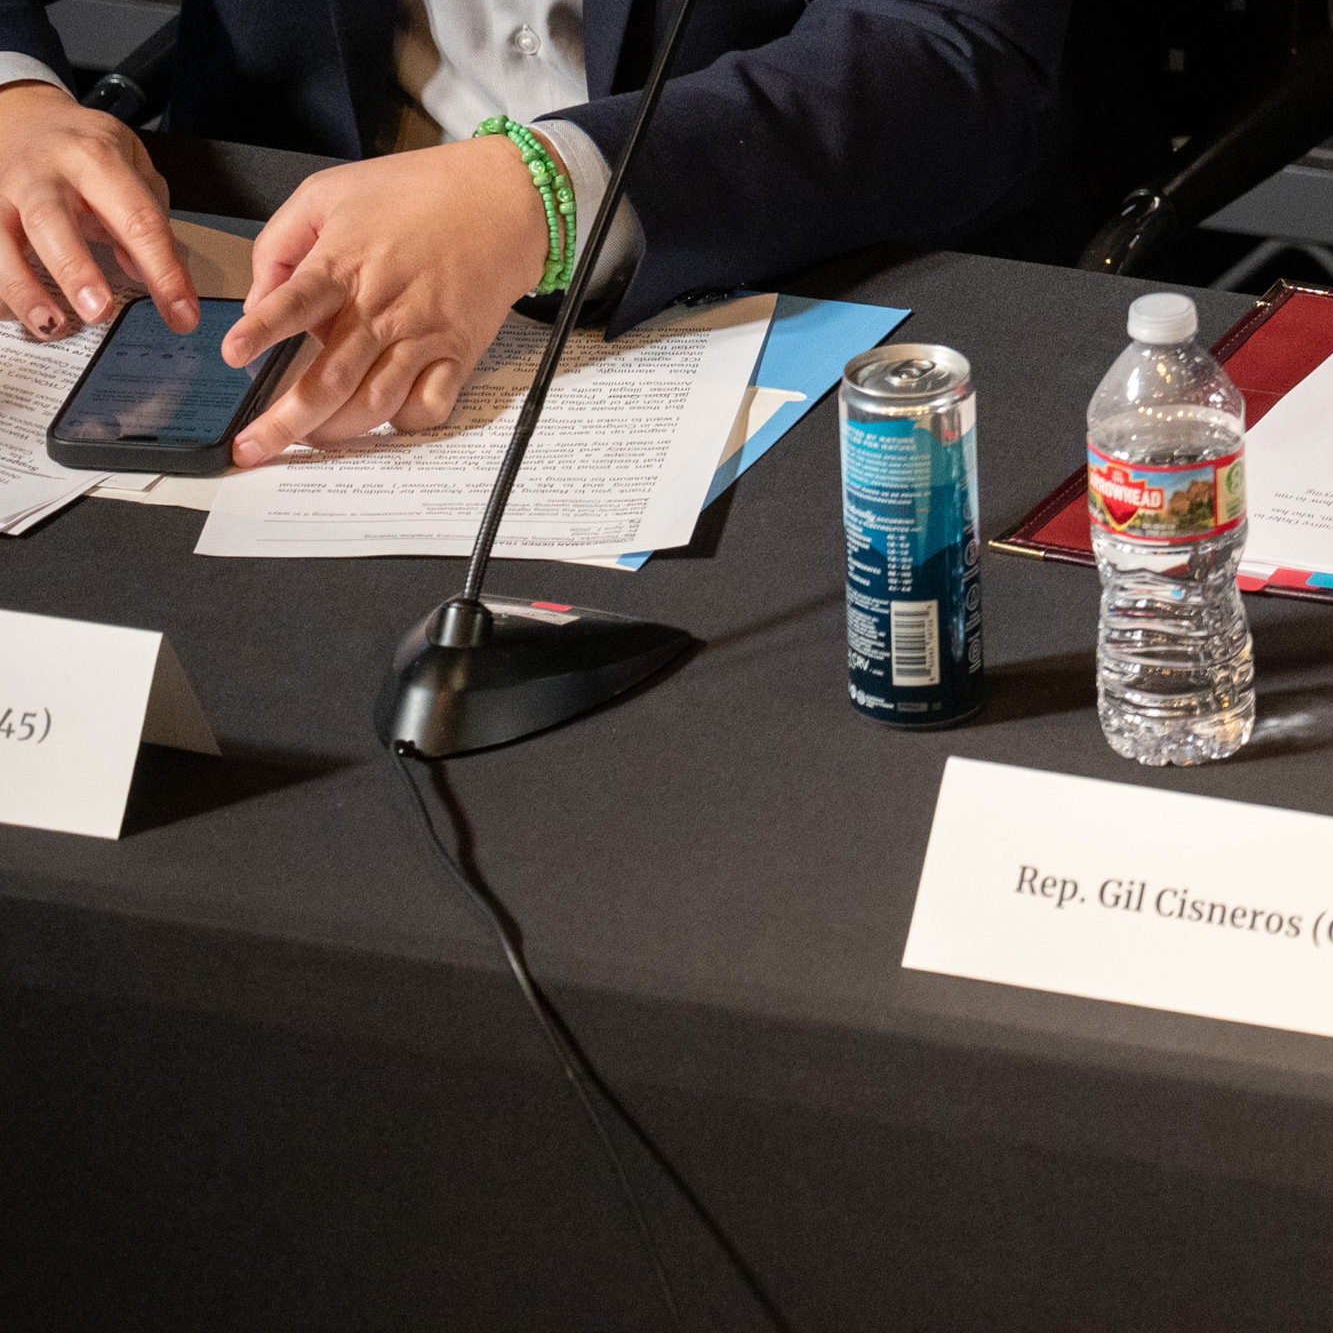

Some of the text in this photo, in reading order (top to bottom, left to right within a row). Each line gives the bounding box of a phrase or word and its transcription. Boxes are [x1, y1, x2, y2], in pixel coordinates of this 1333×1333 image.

[1088, 471, 1161, 508] ARROWHEAD
[0, 707, 51, 744] 45)
[1015, 865, 1087, 909] Rep.
[1098, 878, 1147, 914] Gil
[1153, 886, 1302, 939] Cisneros
